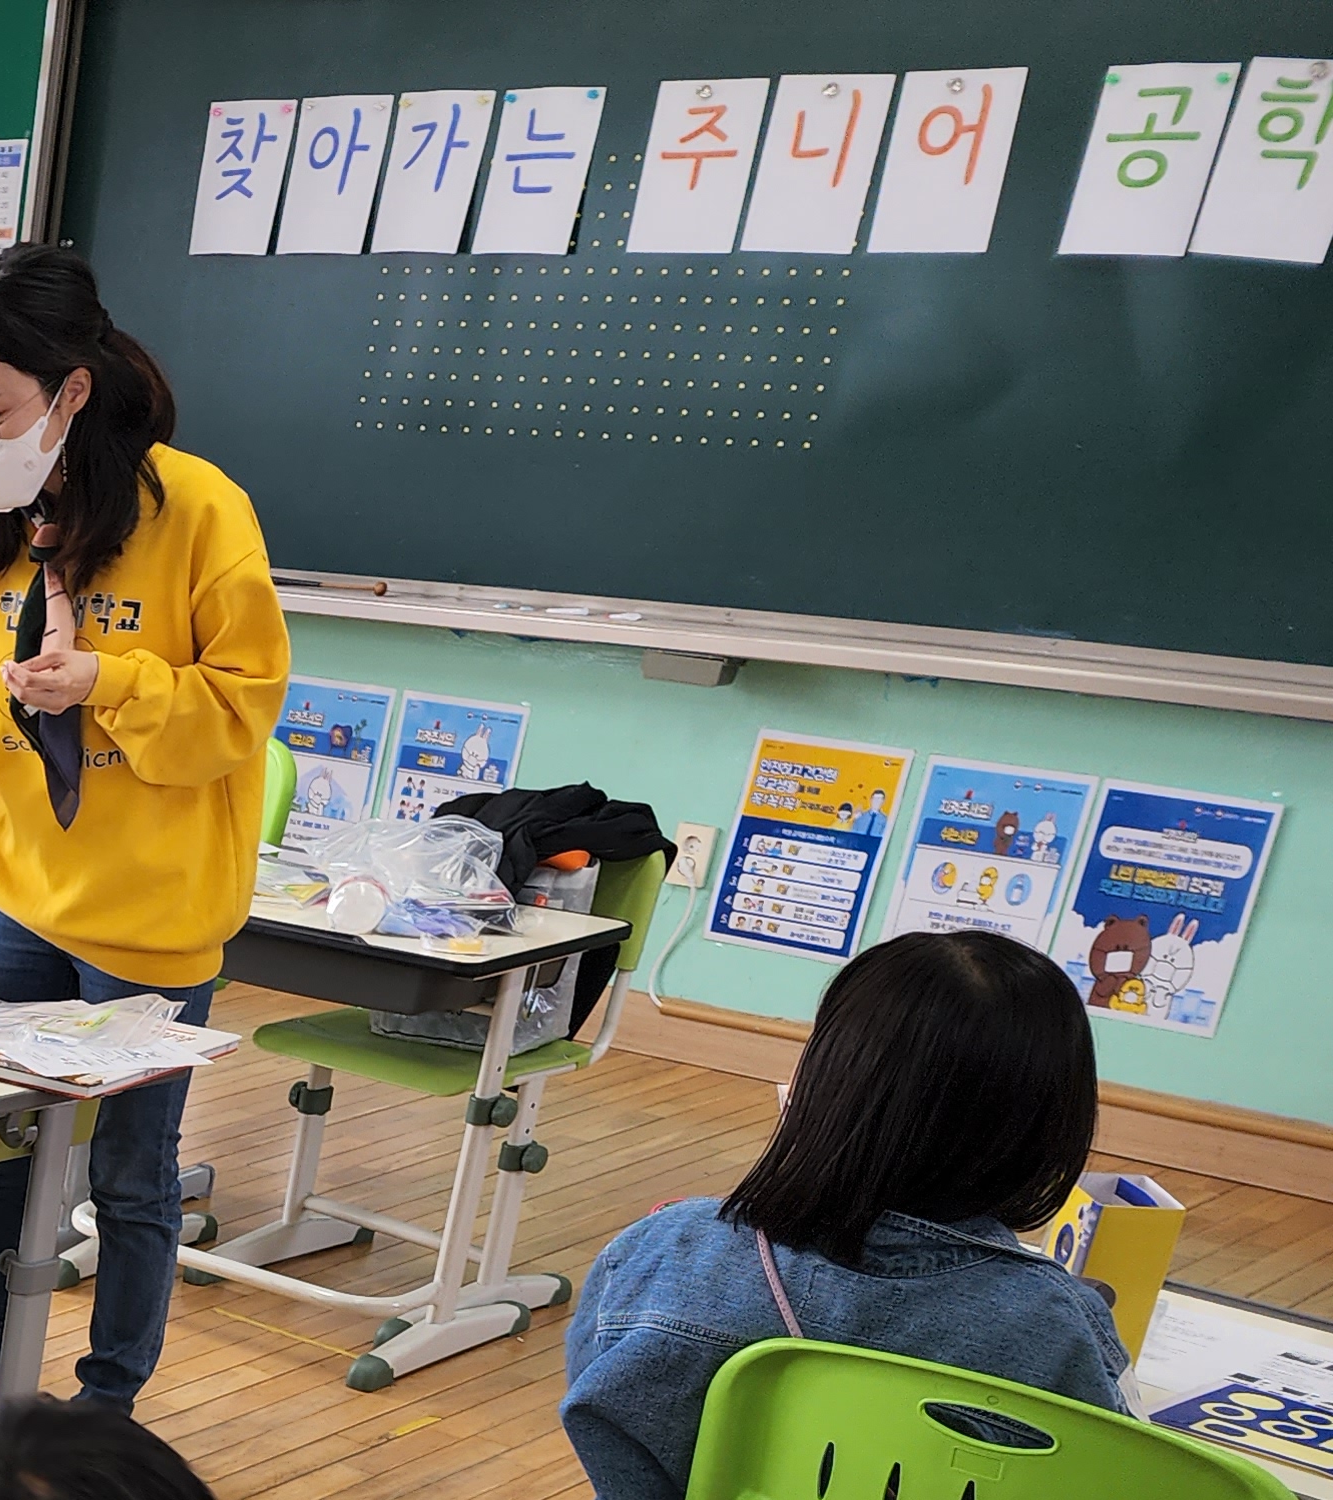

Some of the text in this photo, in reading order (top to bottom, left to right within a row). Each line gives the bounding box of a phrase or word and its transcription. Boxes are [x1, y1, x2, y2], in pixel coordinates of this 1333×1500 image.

[215, 104, 577, 201] 찾아가는
[660, 83, 994, 190] 주니어
[0, 591, 143, 635] 한학교
